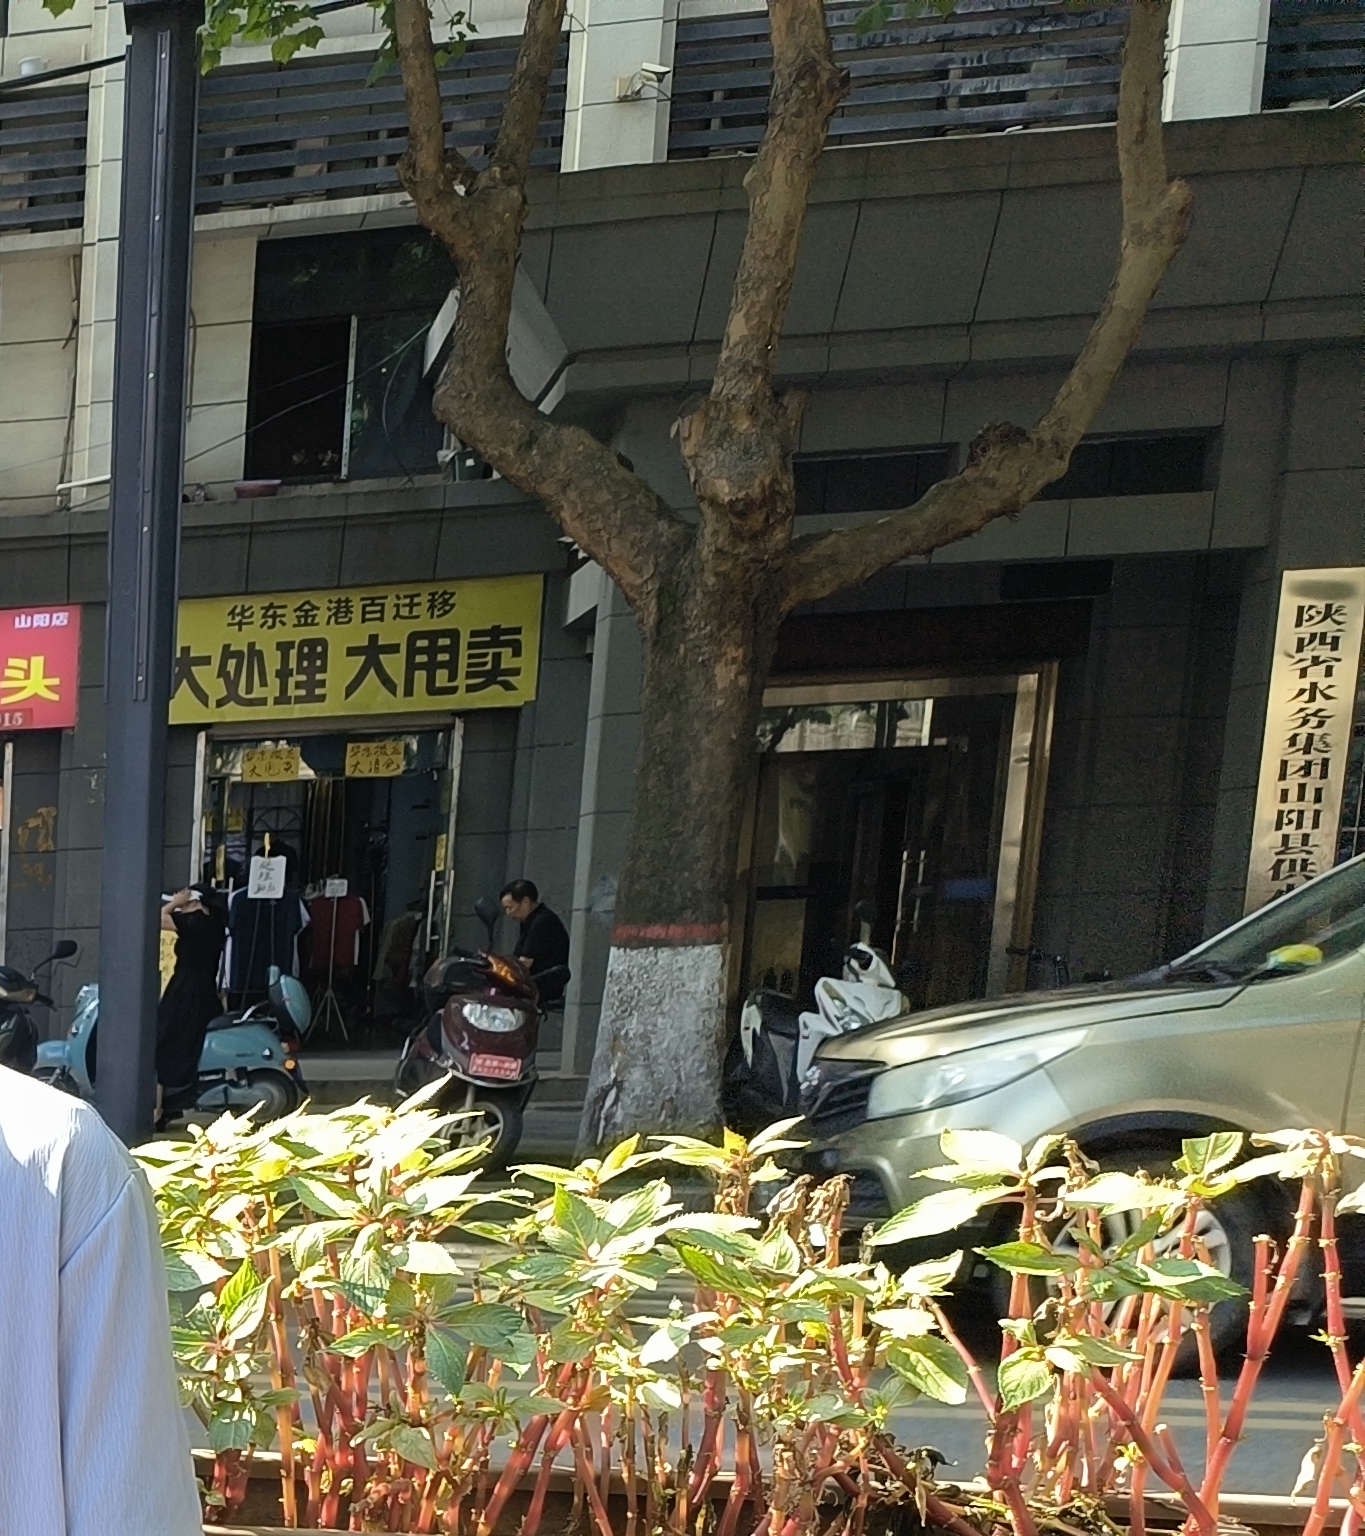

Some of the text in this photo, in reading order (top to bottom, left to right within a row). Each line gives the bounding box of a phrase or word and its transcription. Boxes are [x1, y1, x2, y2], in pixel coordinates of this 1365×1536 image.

[14, 612, 69, 629] 山阳店
[227, 589, 457, 632] 华东金港百迁移
[170, 624, 523, 709] 大处理 大甩卖
